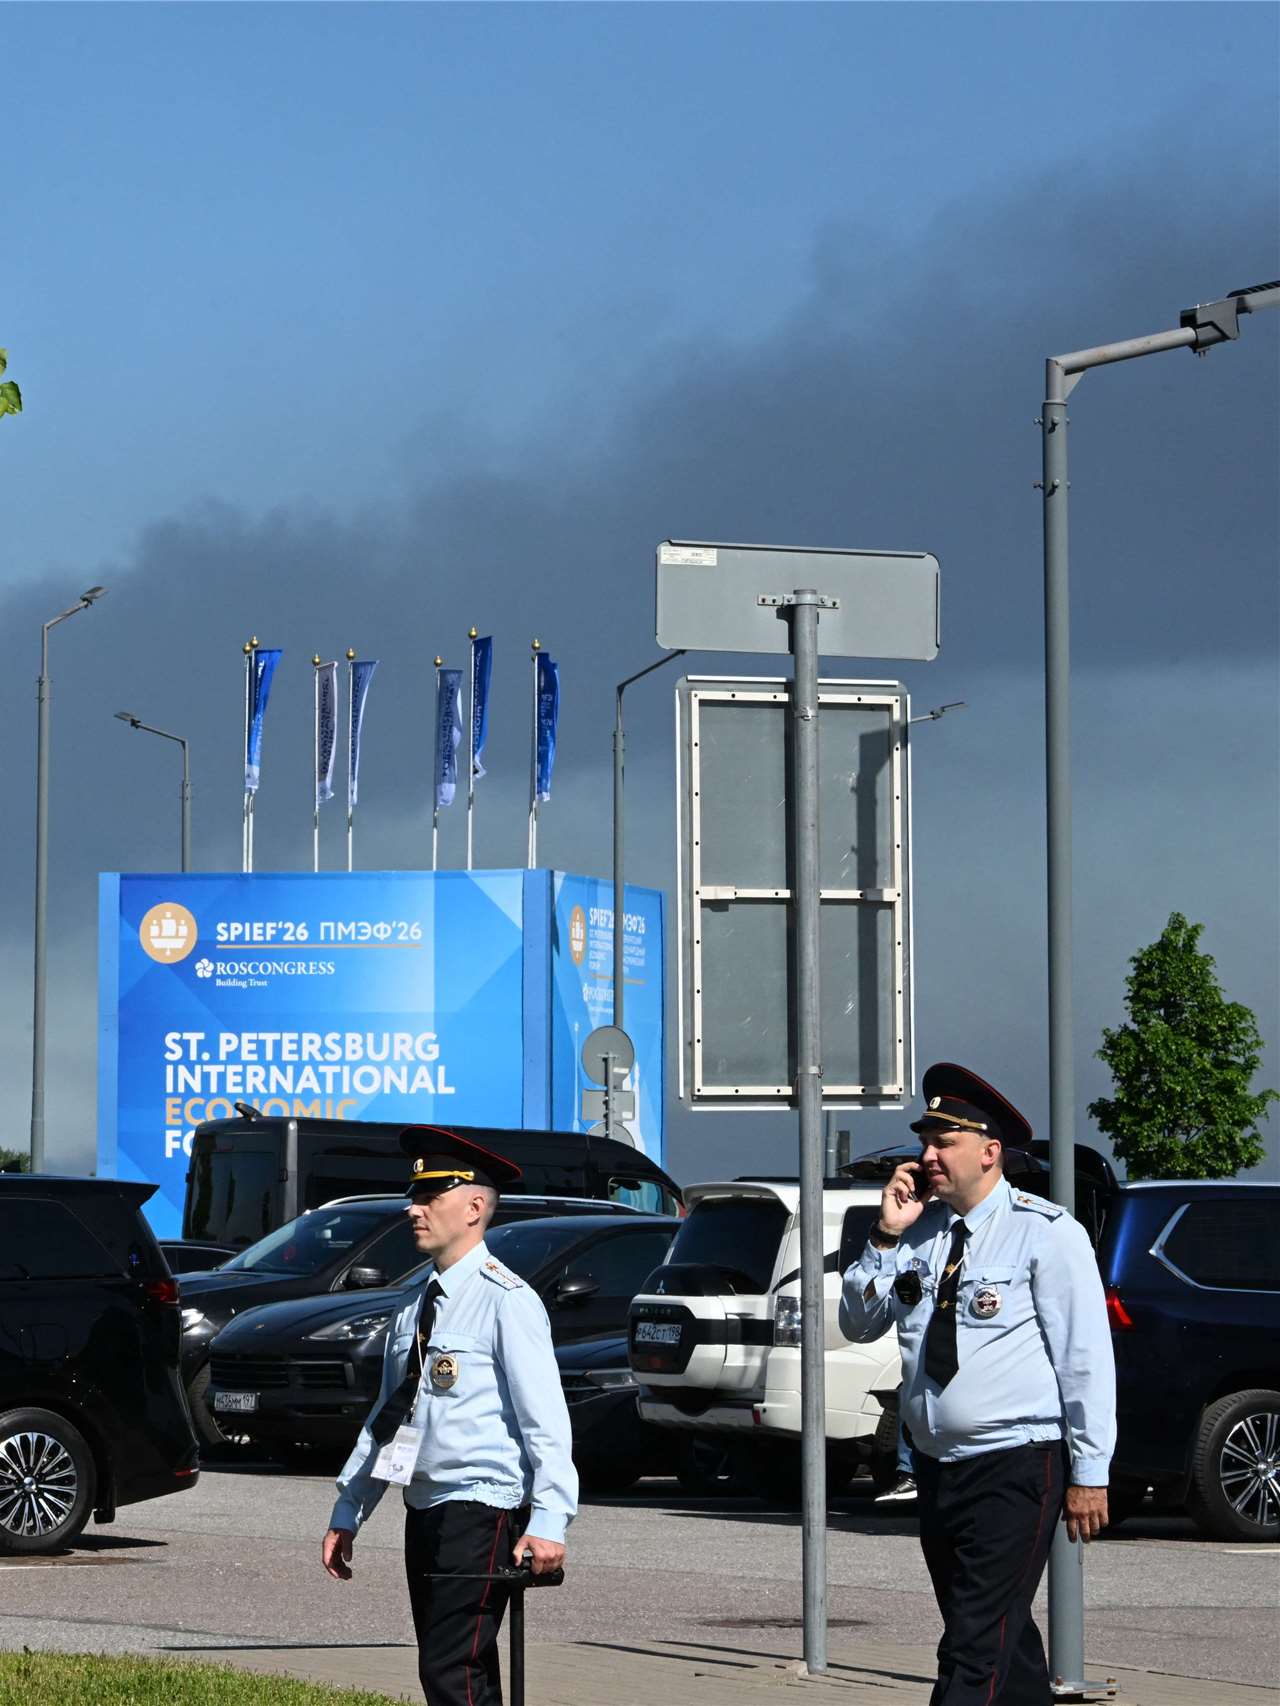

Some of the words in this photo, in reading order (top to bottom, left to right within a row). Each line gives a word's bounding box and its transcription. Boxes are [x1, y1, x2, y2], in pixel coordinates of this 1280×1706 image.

[216, 961, 335, 975] ROSCONGRESS
[216, 978, 247, 988] Building
[248, 978, 268, 987] Trust
[165, 1032, 210, 1061] ST.
[219, 1032, 439, 1061] PETERSBURG
[166, 1065, 455, 1095] INTERNATIONAL
